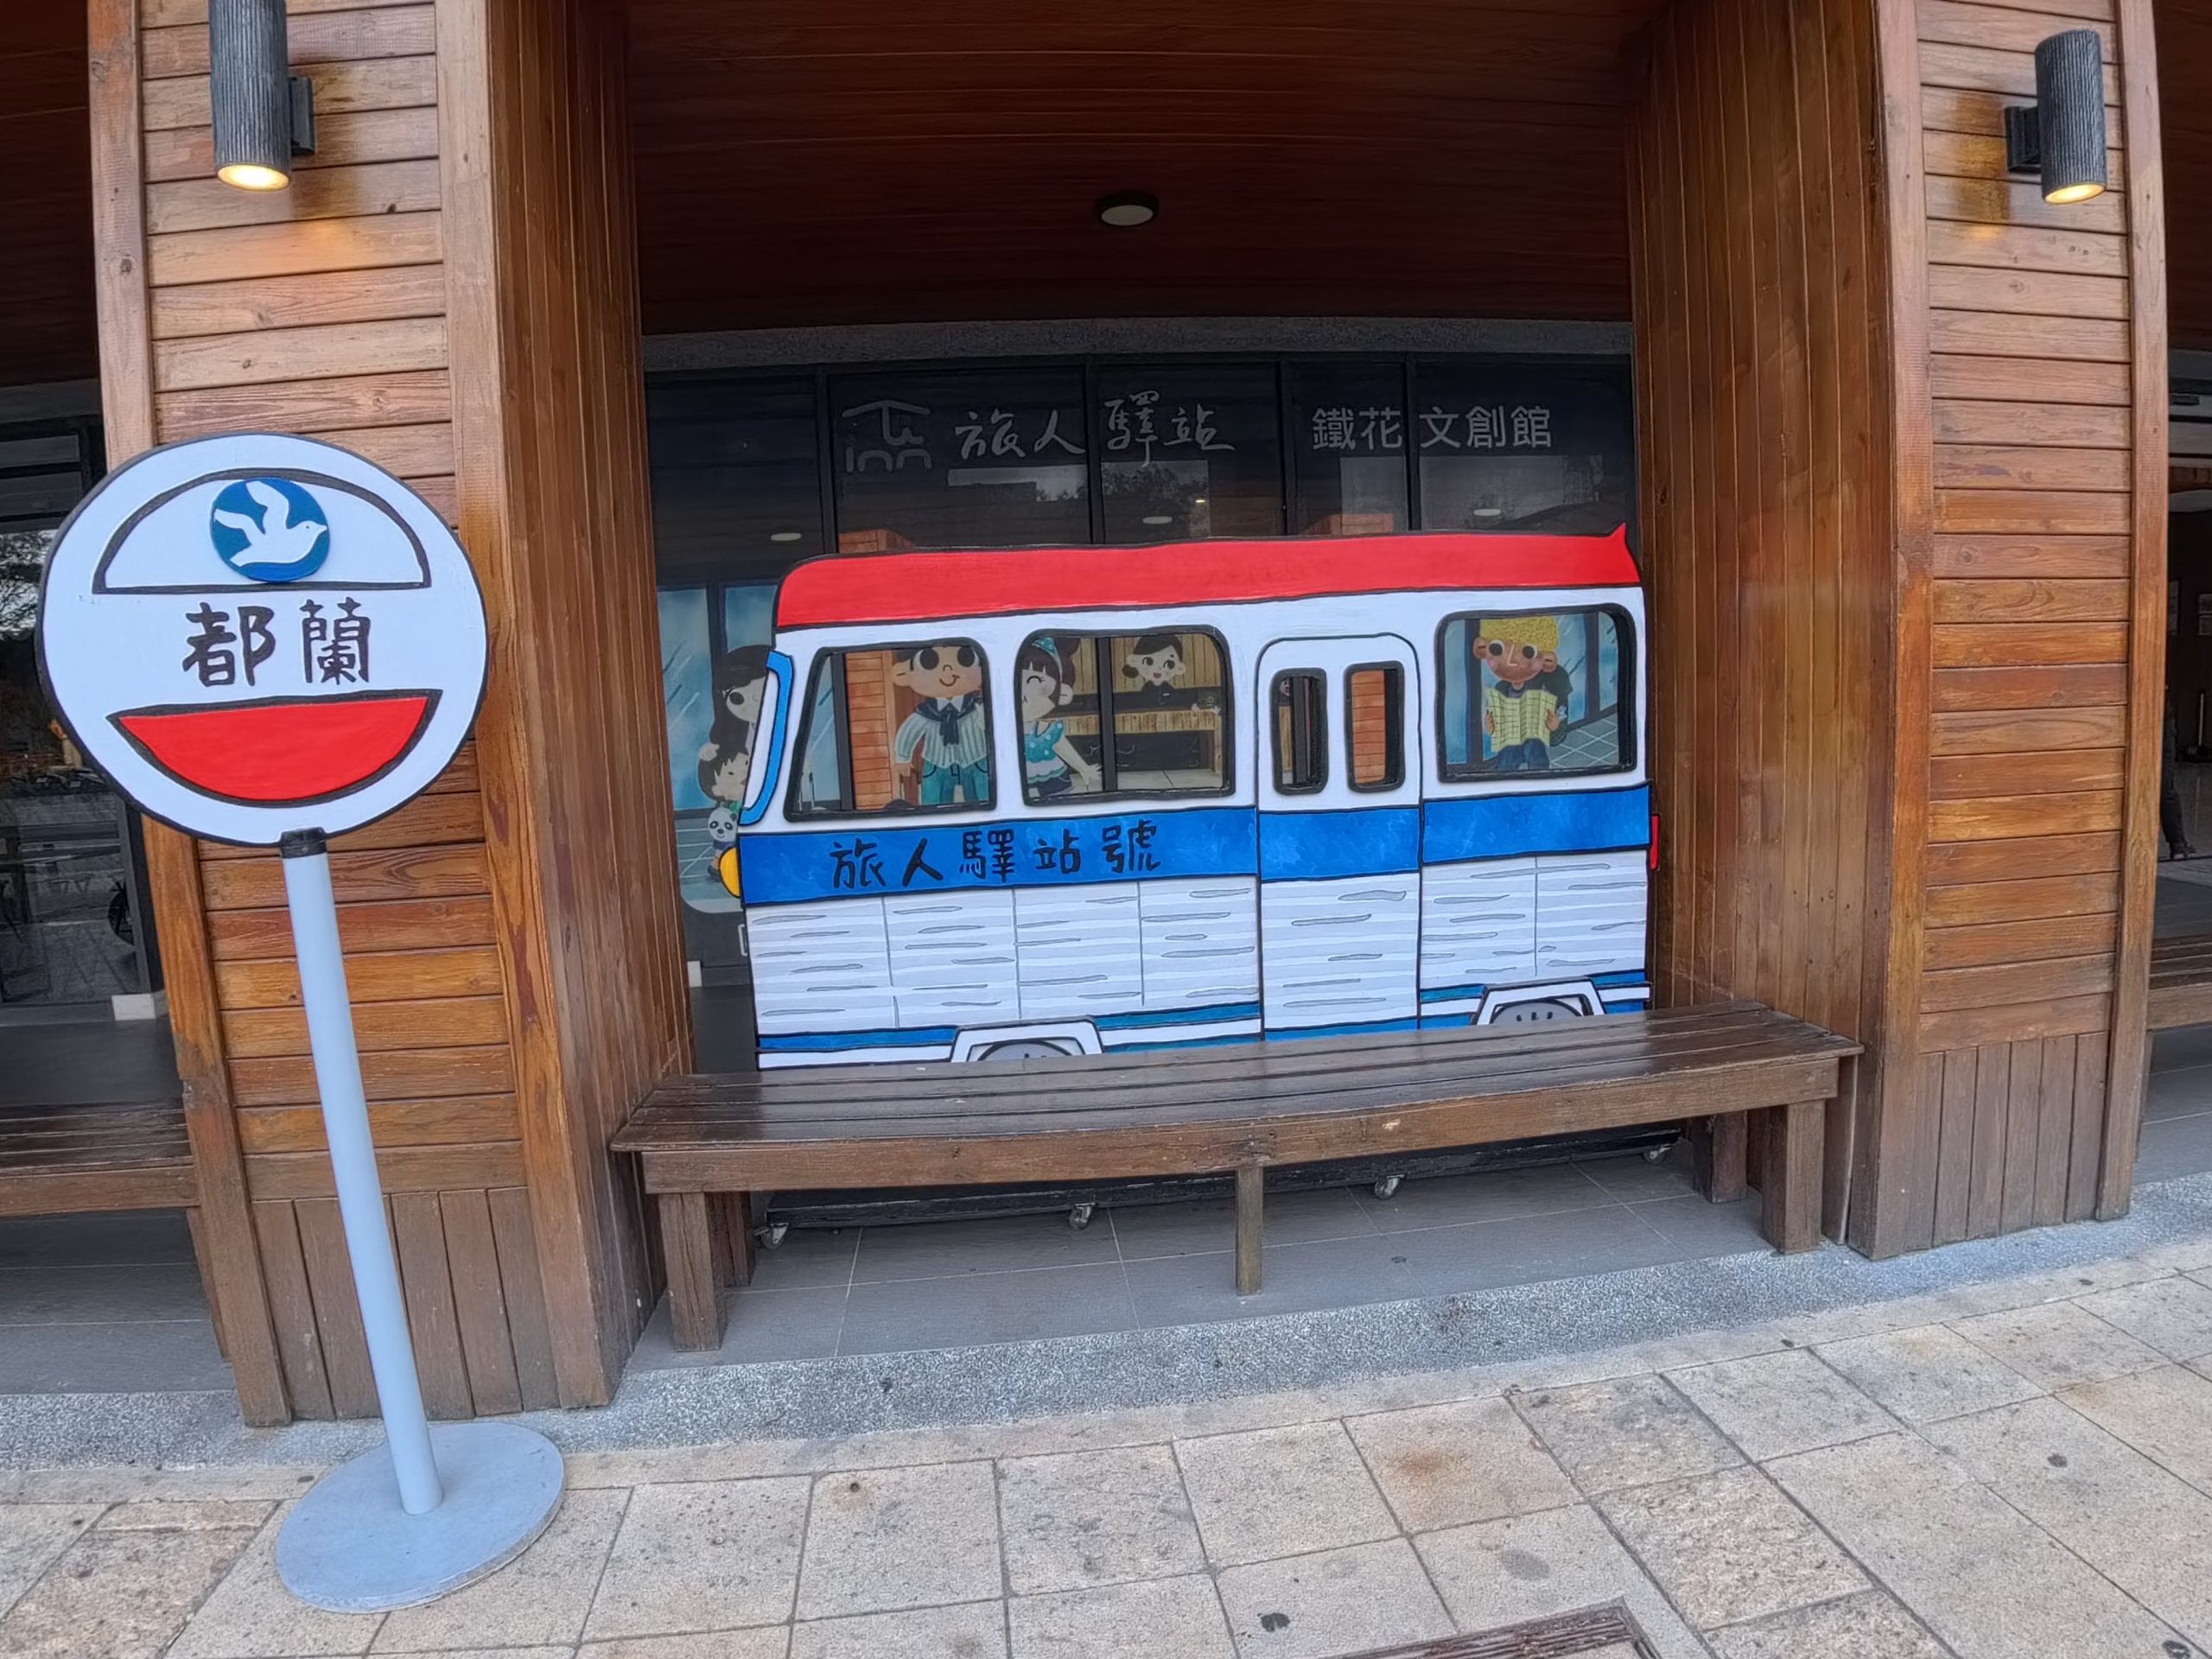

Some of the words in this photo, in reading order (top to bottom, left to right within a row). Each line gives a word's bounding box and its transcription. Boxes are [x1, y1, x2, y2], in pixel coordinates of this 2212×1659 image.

[181, 596, 372, 688] 都蘭
[830, 818, 1161, 889] 旅人驛站號
